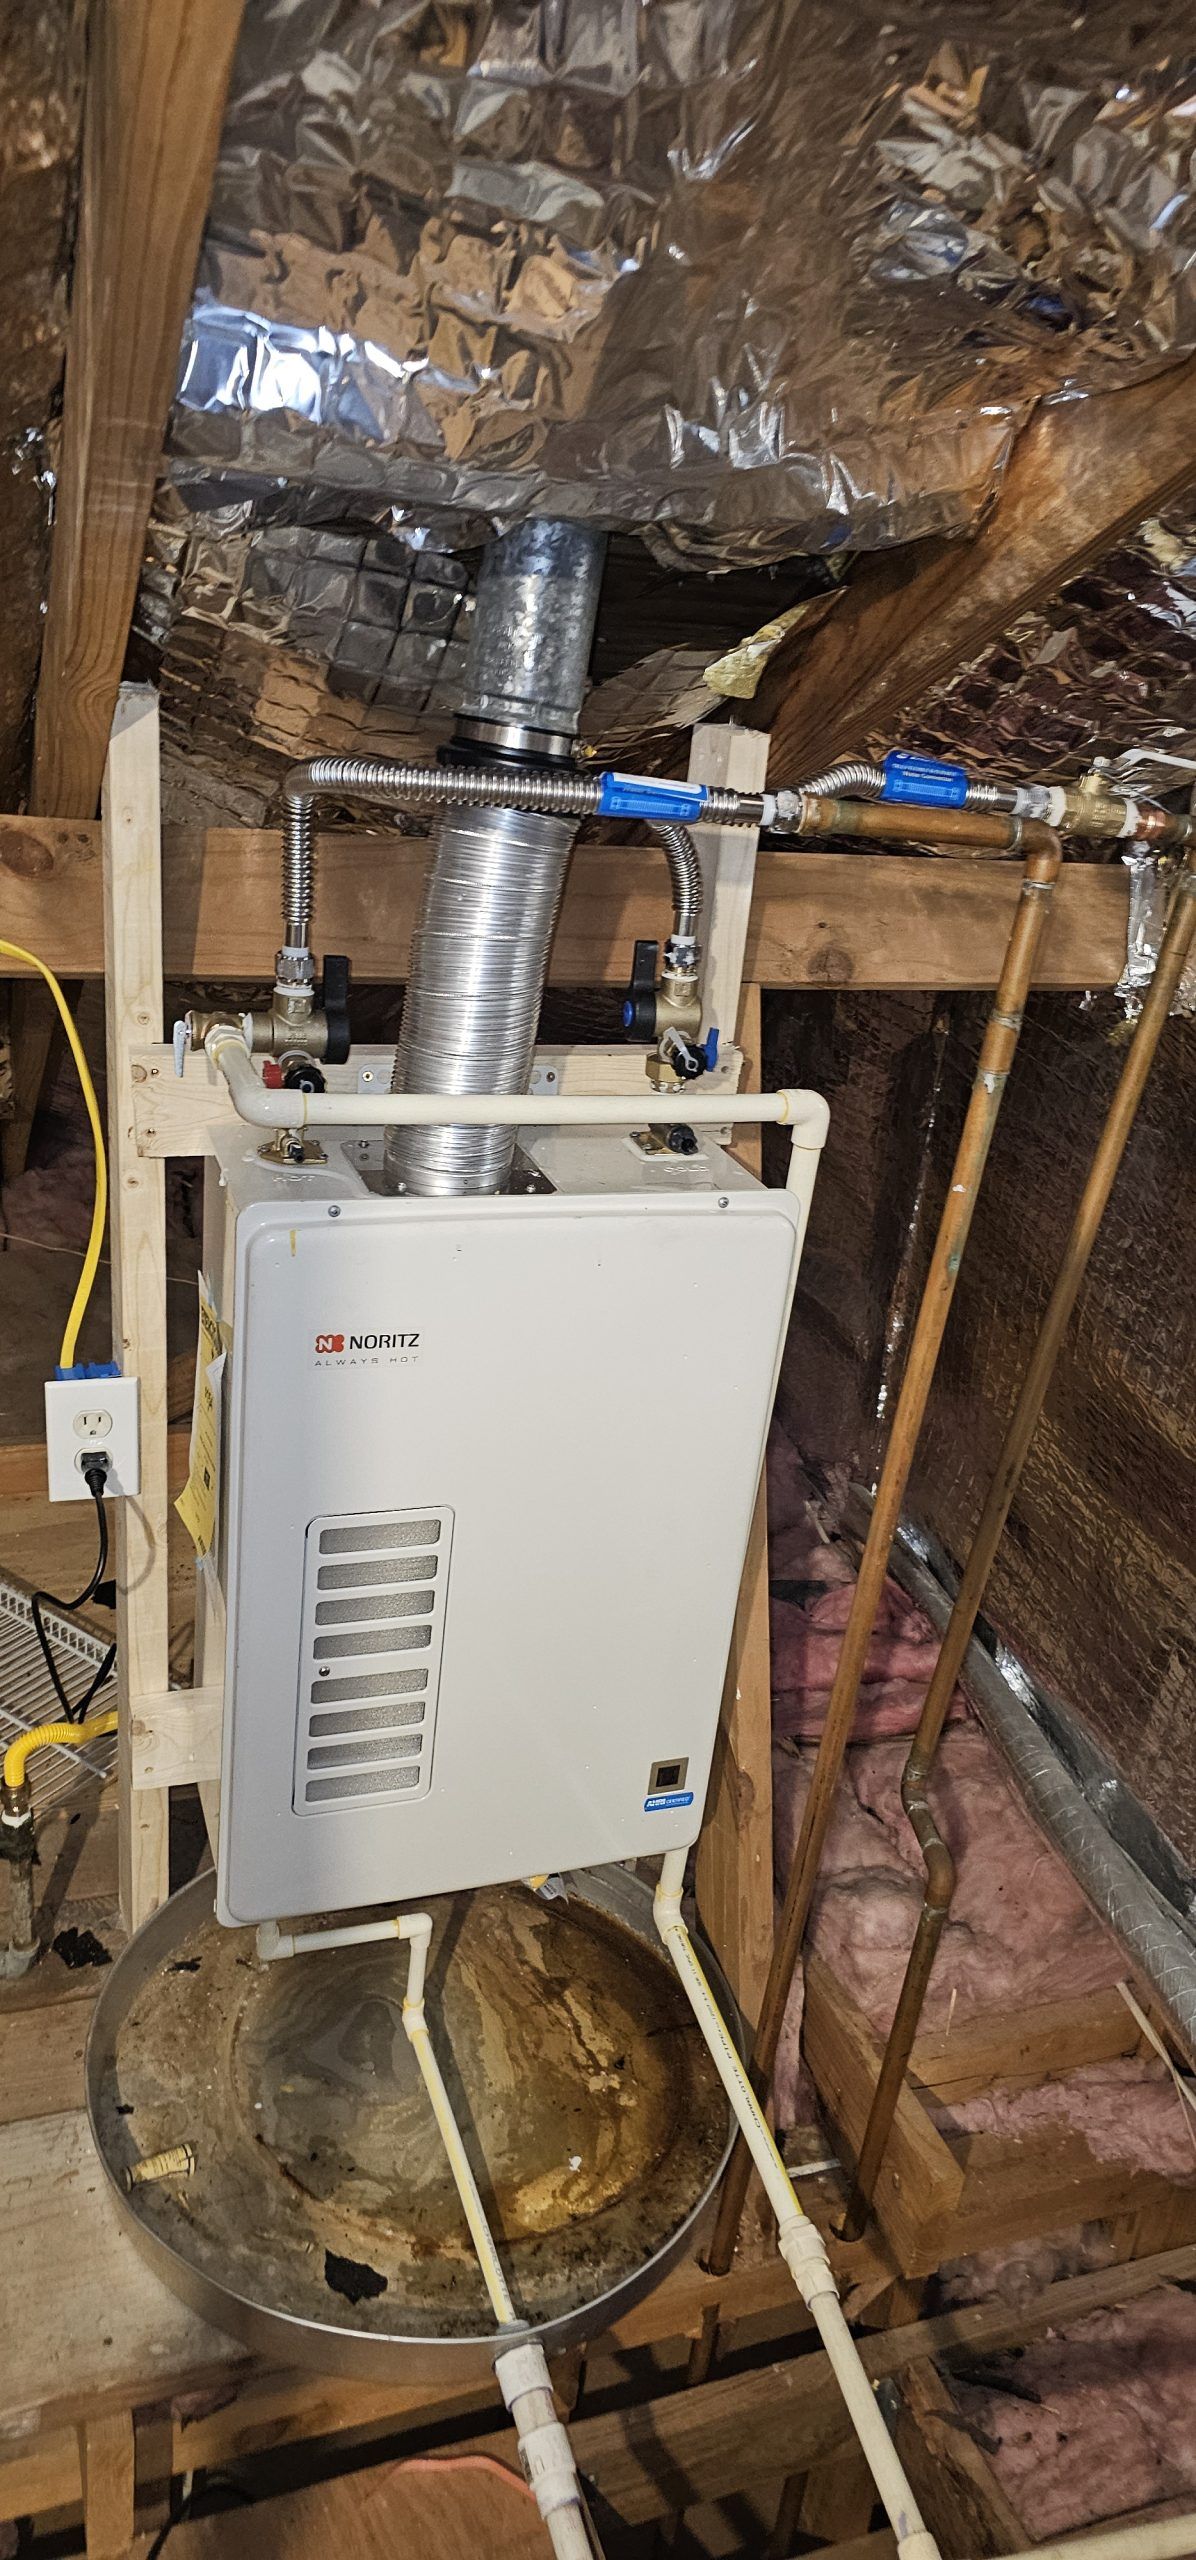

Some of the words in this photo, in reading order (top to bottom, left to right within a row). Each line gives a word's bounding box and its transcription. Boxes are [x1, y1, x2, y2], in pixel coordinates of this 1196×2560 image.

[349, 1333, 420, 1350] NORITZ
[314, 1357, 379, 1367] ALWAYS
[389, 1355, 419, 1364] HOT
